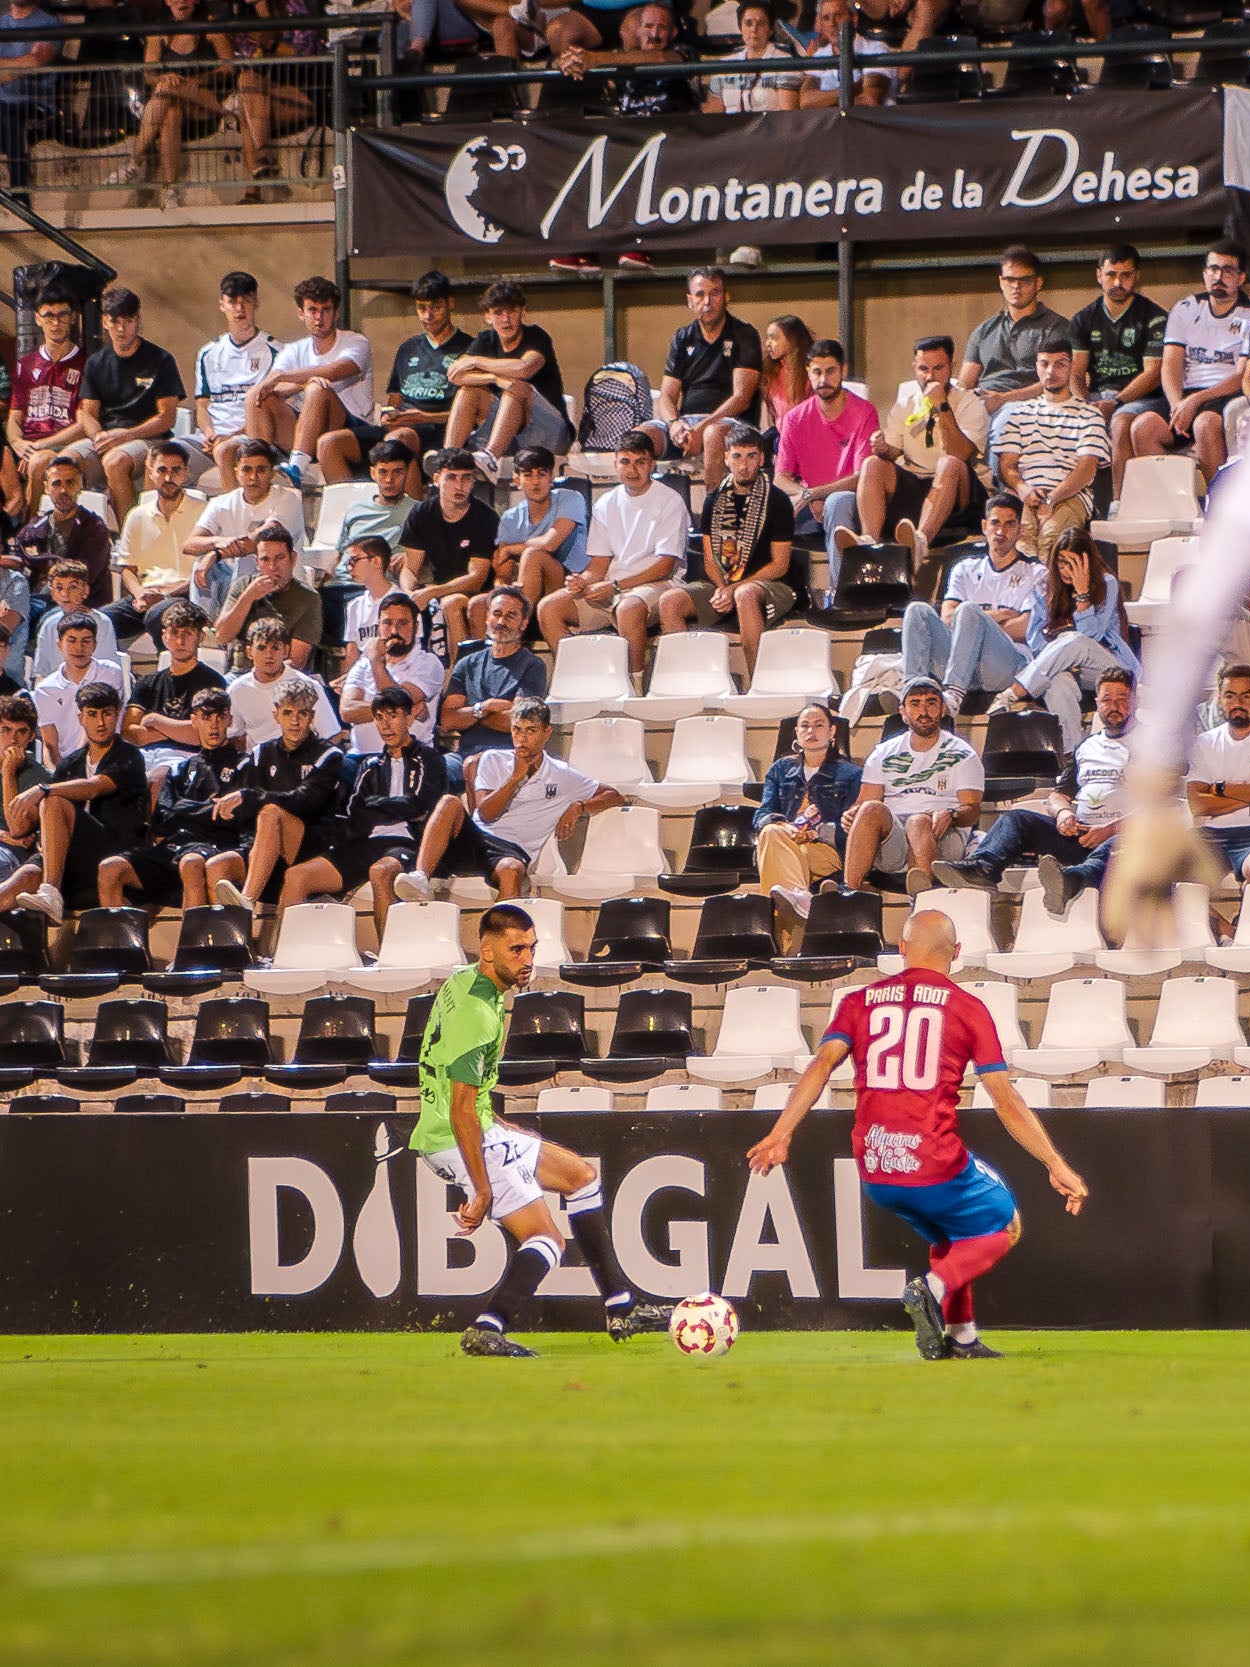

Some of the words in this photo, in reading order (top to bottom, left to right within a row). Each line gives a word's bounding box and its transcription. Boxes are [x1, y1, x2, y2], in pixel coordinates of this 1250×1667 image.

[539, 131, 885, 240] Montanera
[900, 170, 943, 211] de
[951, 169, 985, 209] la
[1000, 128, 1200, 208] Dehesa
[865, 985, 906, 1007] PARIS
[866, 1005, 945, 1091] 20
